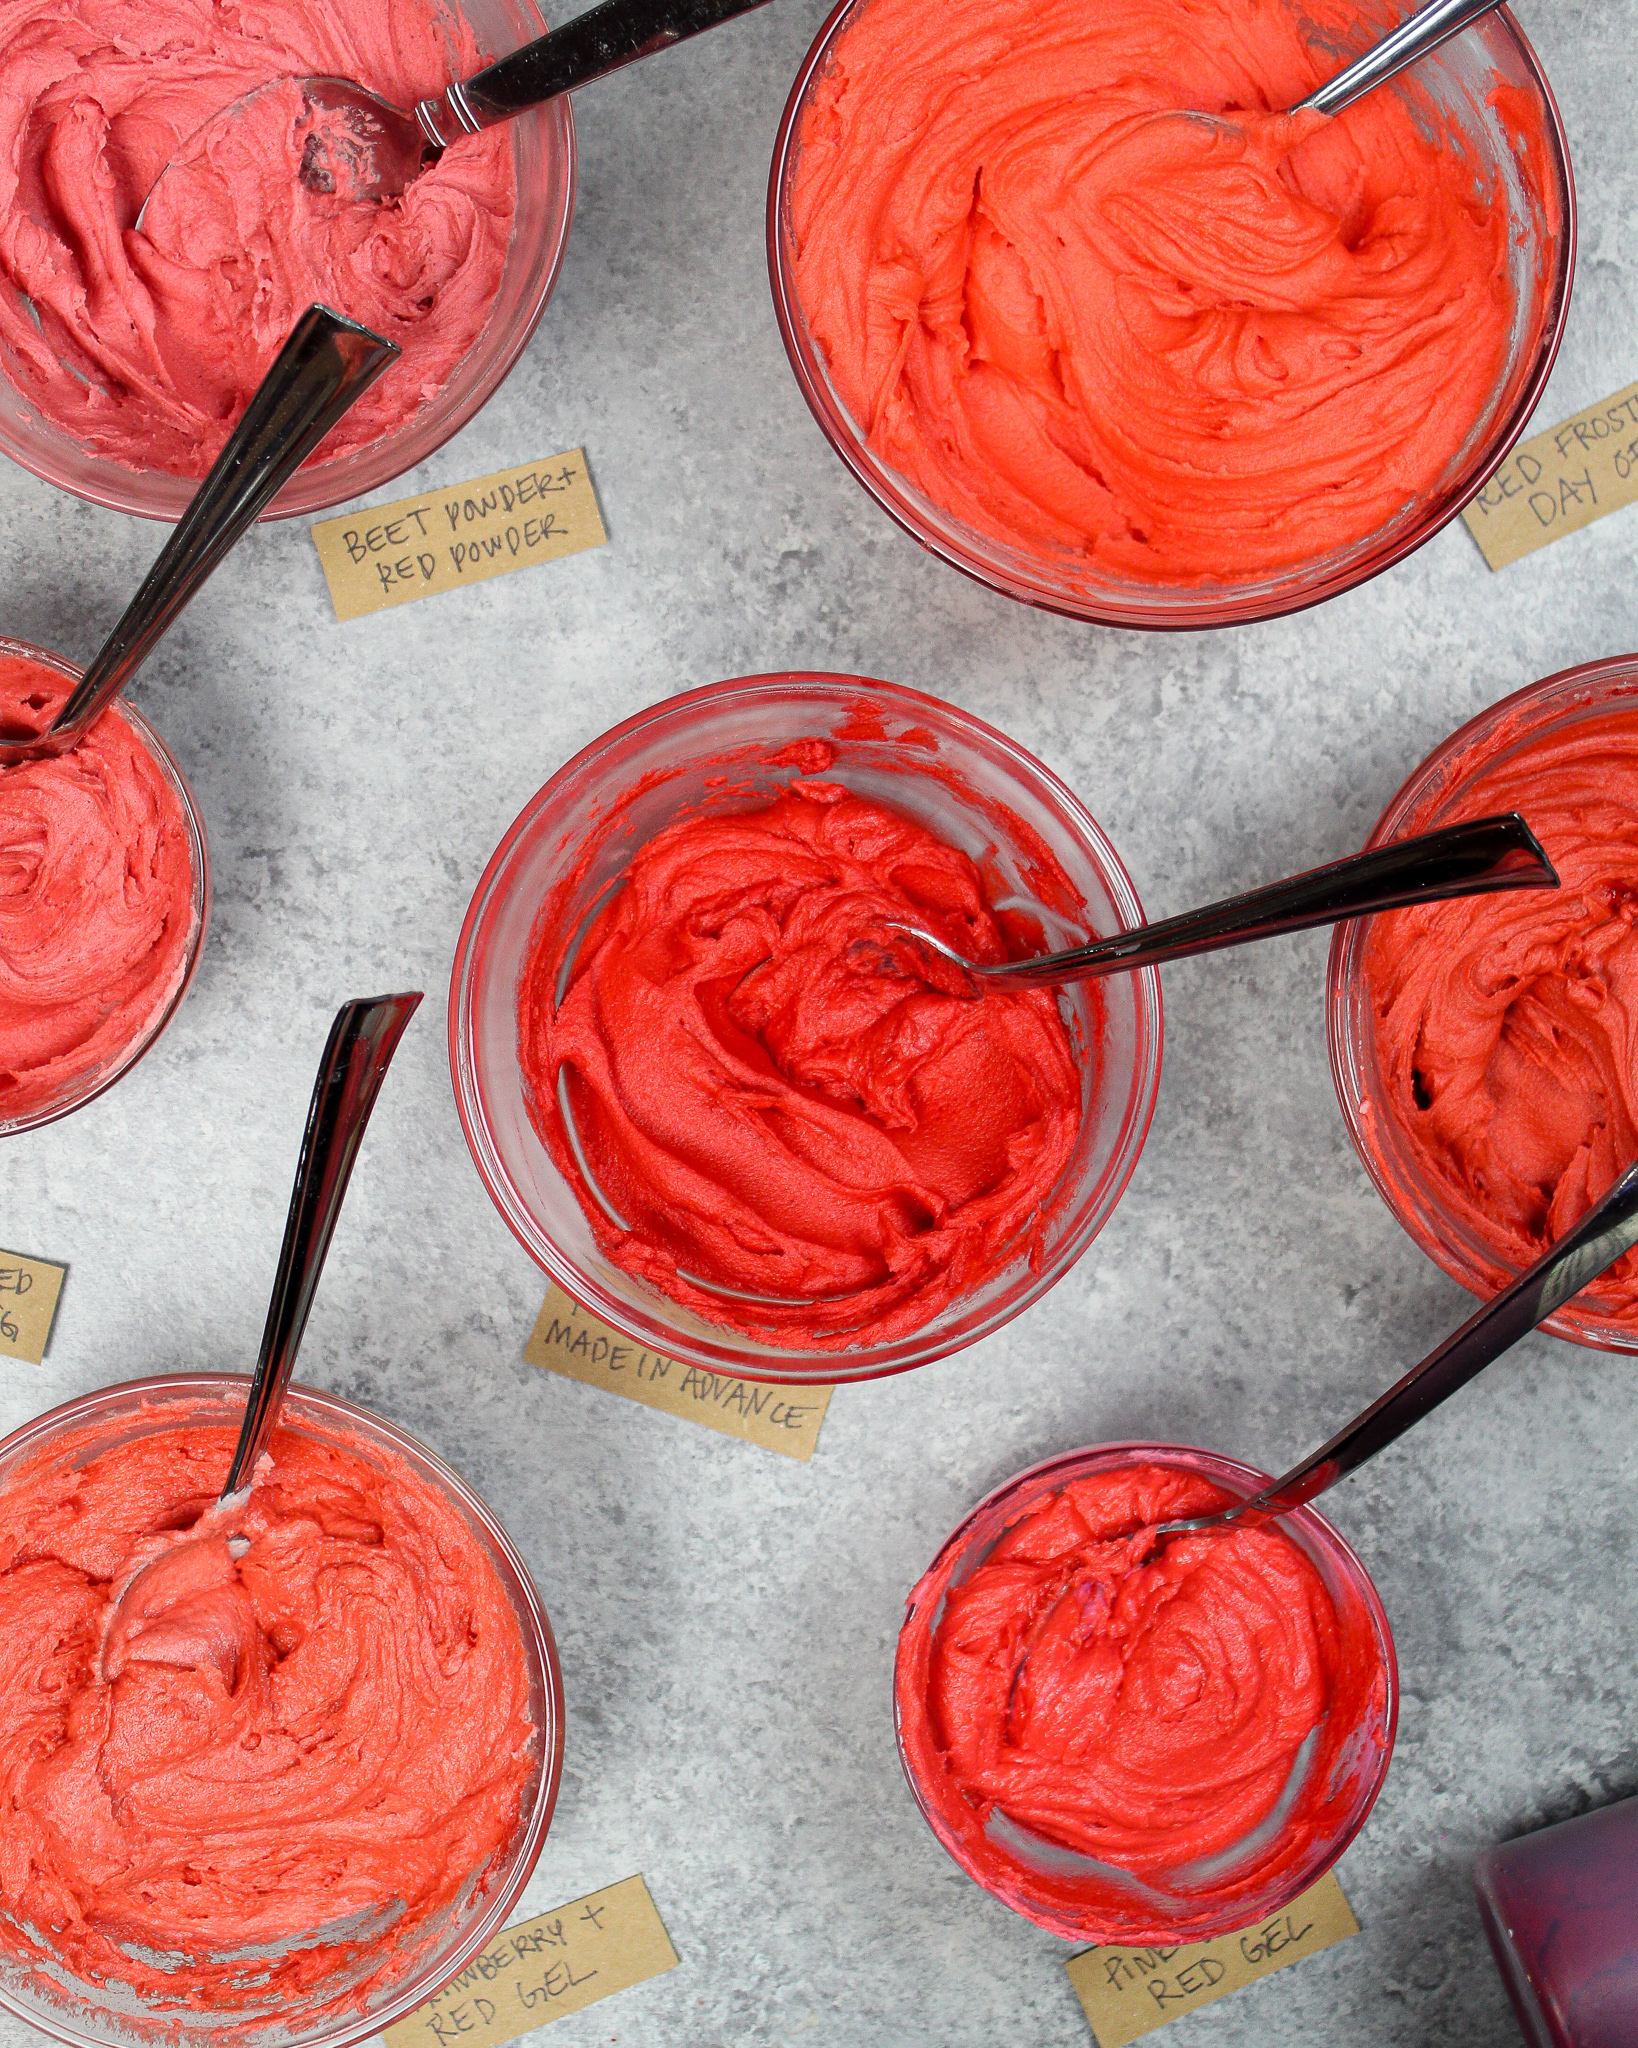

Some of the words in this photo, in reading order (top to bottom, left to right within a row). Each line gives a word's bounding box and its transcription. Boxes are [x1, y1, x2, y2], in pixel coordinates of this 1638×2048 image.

[1475, 454, 1542, 516] RED
[1554, 394, 1638, 459] FROST
[342, 507, 431, 564] BEET
[1528, 467, 1598, 527] DAY
[376, 552, 436, 593] RED
[449, 514, 568, 573] POWDER
[0, 1268, 33, 1296] ED
[543, 1318, 634, 1372] MADE
[636, 1353, 674, 1382] IN
[679, 1367, 820, 1430] ADVANCE
[426, 1997, 496, 2046] RED
[515, 1960, 598, 2009] GEL
[1147, 1957, 1225, 2010] RED
[1240, 1916, 1313, 1965] GEL
